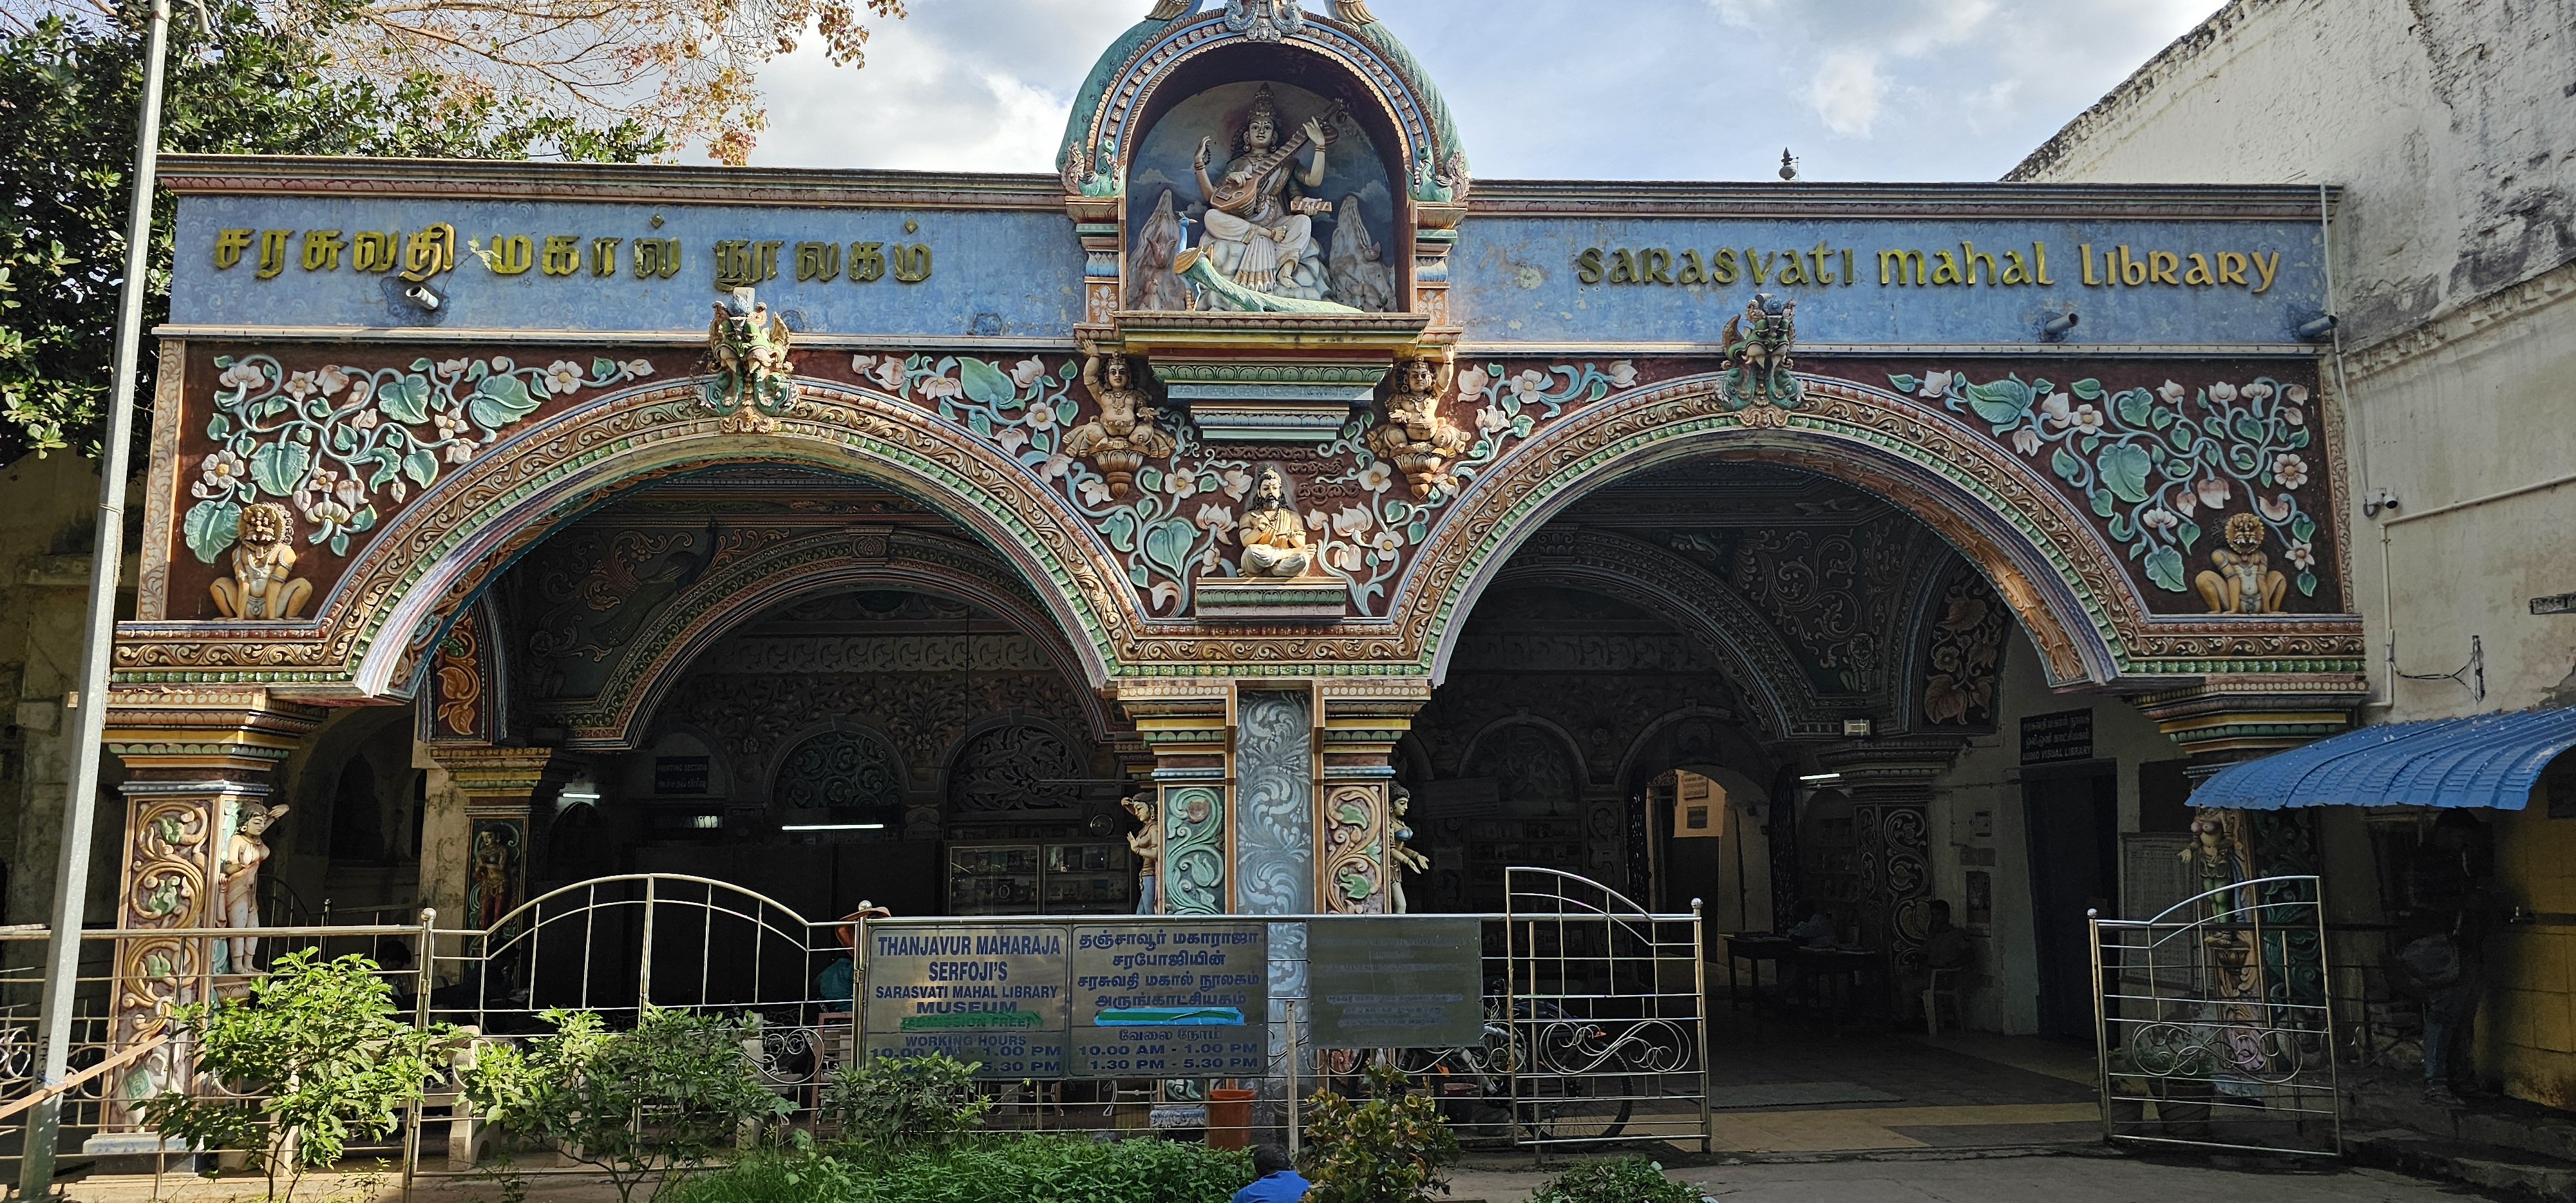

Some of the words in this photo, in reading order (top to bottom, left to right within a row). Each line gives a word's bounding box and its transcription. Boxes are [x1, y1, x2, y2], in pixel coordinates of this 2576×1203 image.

[214, 221, 455, 282] சரசுவதி
[491, 213, 681, 279] மகால்
[713, 217, 932, 291] நூலகம்
[2064, 746, 2091, 757] LIBRARY
[878, 936, 971, 956] THANJAVUR
[976, 936, 1060, 954] MAHARAJA
[1079, 929, 1166, 951] தஞ்சாவூர்
[1173, 933, 1258, 947] மகாராஜா
[1112, 949, 1226, 970] சரபோஜியின்
[1077, 972, 1139, 991] சரசுவதி
[1146, 971, 1193, 986] மகால்
[1200, 970, 1259, 992] நூலகம்
[876, 986, 947, 998] SARASVATI
[952, 986, 998, 998] MAHAL
[1002, 985, 1058, 998] LIBRARY
[1095, 991, 1247, 1009] அருங்காட்சியகம்
[916, 1001, 1017, 1014] MUSEUM
[905, 1036, 972, 1046] WORKING
[978, 1036, 1027, 1046] HOURS
[1119, 1029, 1172, 1041] வேலை
[984, 1046, 1024, 1056] 1.00
[1031, 1046, 1061, 1056] PM
[1079, 1046, 1130, 1055] 10.00
[1136, 1045, 1164, 1054] AM
[1184, 1044, 1224, 1054] 1.00
[1229, 1043, 1257, 1053] PM
[981, 1061, 1024, 1072] 5.30
[1031, 1062, 1061, 1072] PM
[1090, 1060, 1130, 1069] 1.30
[1136, 1059, 1164, 1069] PM
[1184, 1059, 1224, 1068] 5.30
[1229, 1058, 1257, 1067] PM
